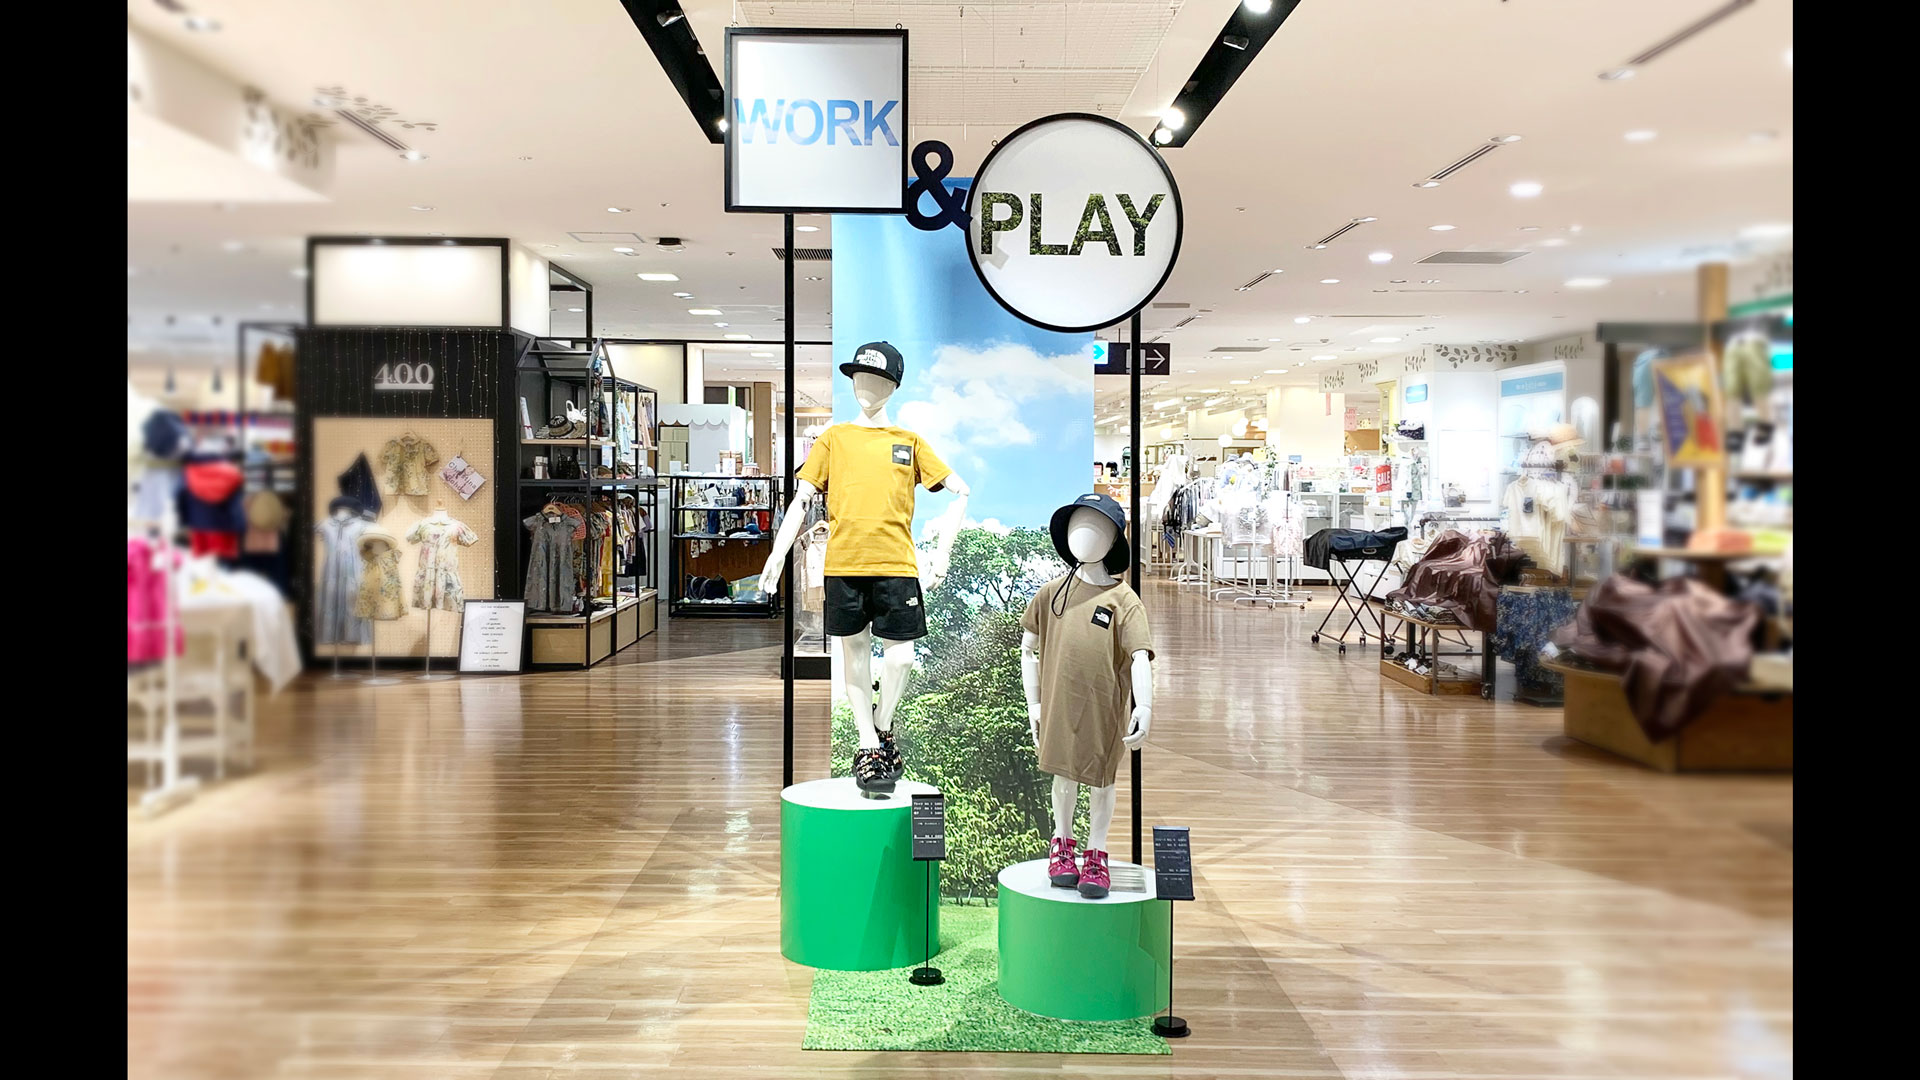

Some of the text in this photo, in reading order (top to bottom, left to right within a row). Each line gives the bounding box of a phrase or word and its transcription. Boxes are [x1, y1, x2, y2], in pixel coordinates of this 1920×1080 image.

[733, 98, 899, 146] WORK
[906, 140, 973, 232] &
[980, 193, 1166, 257] PLAY
[374, 363, 434, 384] 400
[1377, 471, 1391, 485] SALE
